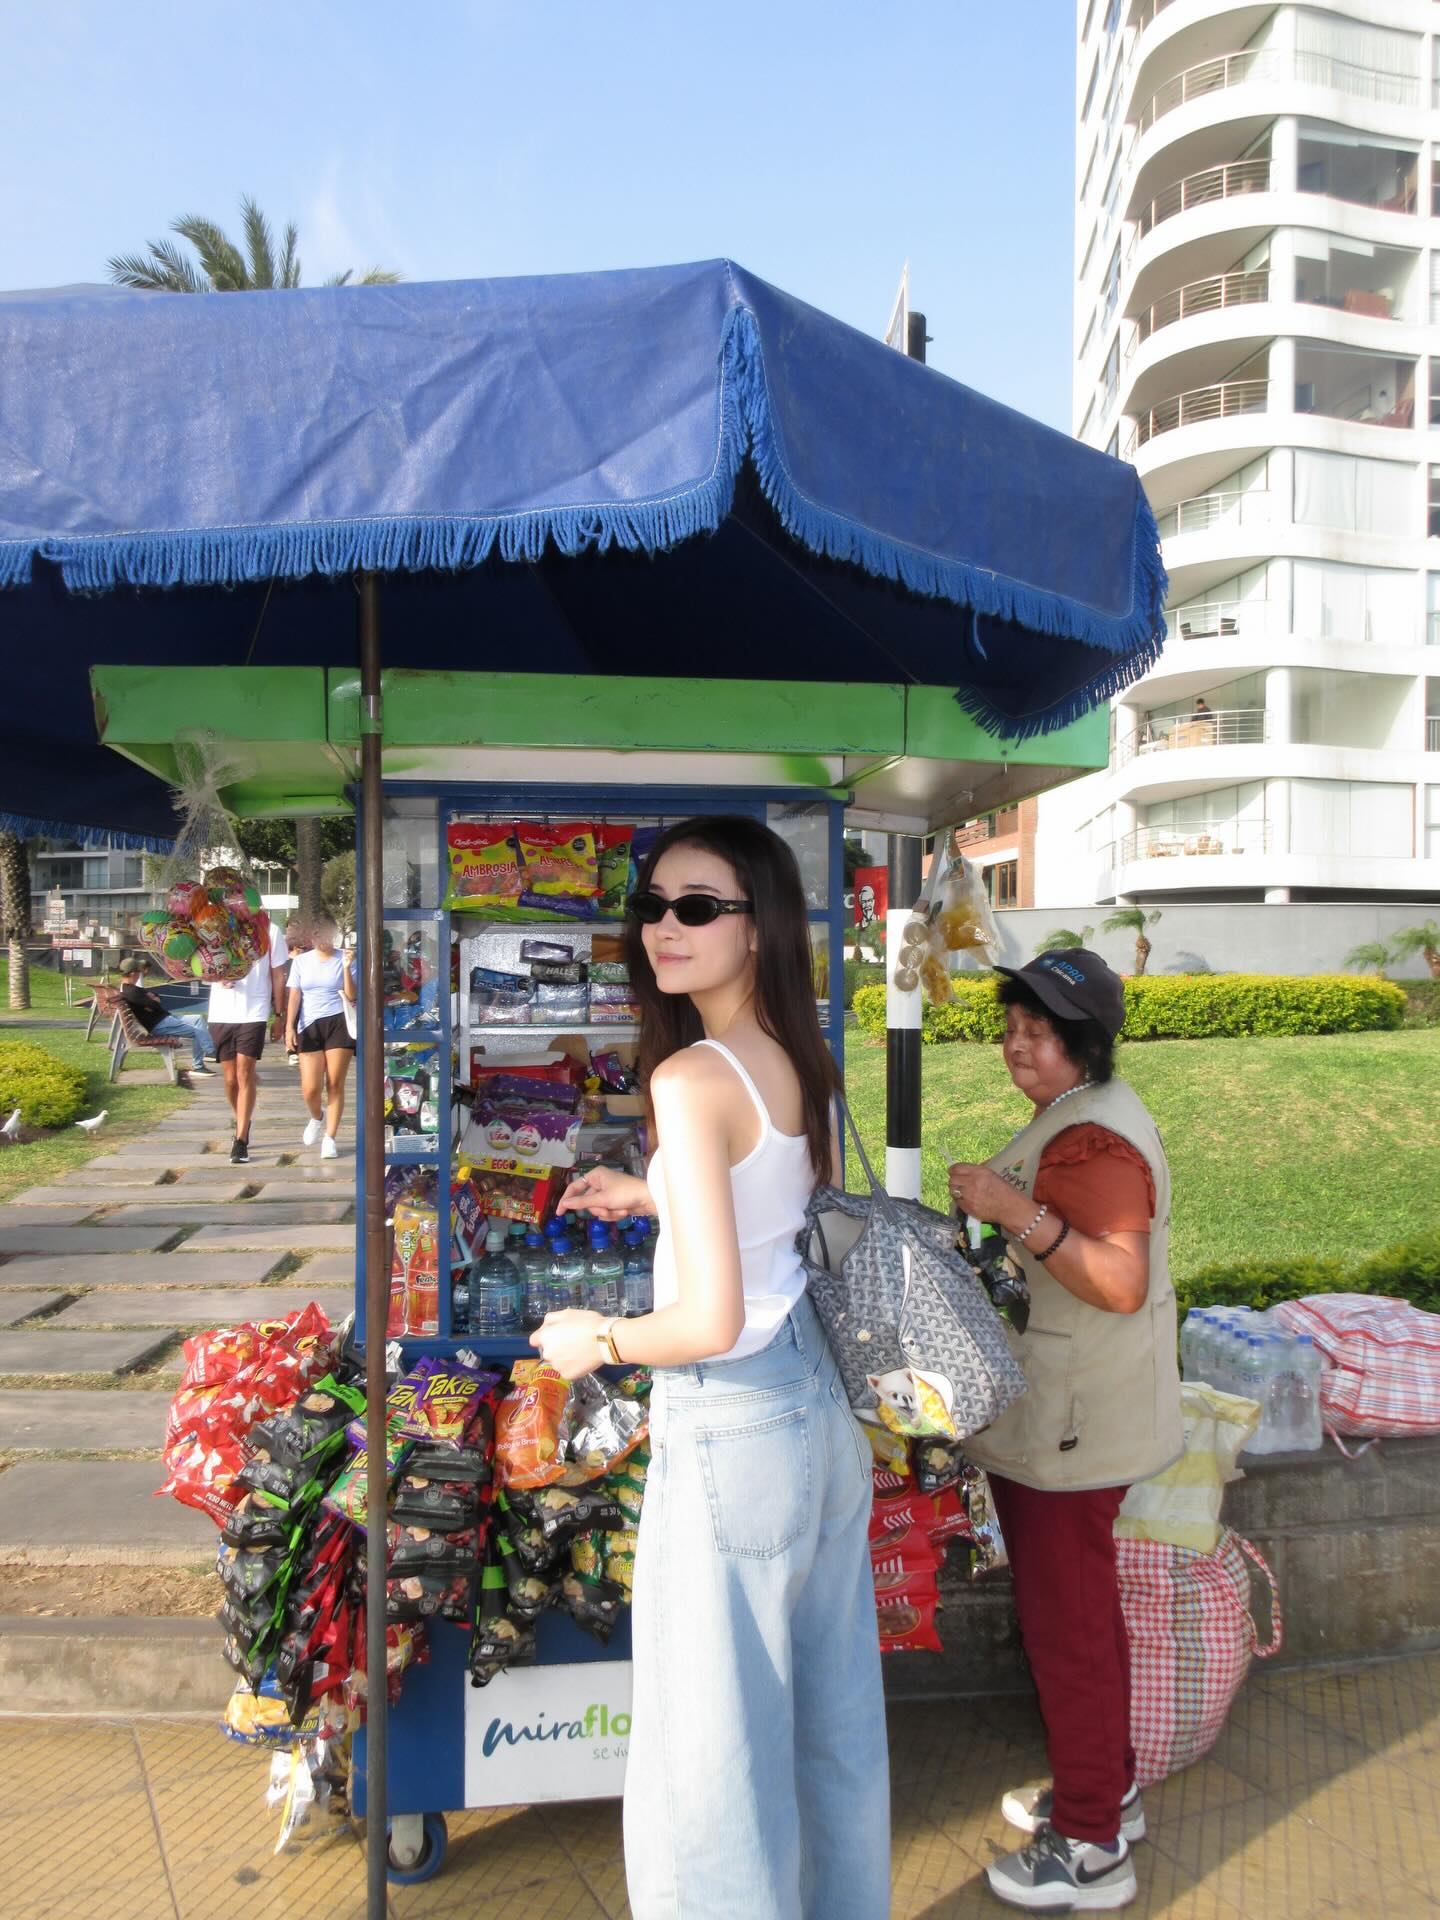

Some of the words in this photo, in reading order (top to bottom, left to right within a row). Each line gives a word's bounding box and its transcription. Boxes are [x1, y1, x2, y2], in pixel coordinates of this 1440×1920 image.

[462, 862, 519, 879] AMBROSIA
[546, 967, 576, 976] HALLS
[423, 1373, 480, 1401] Takis
